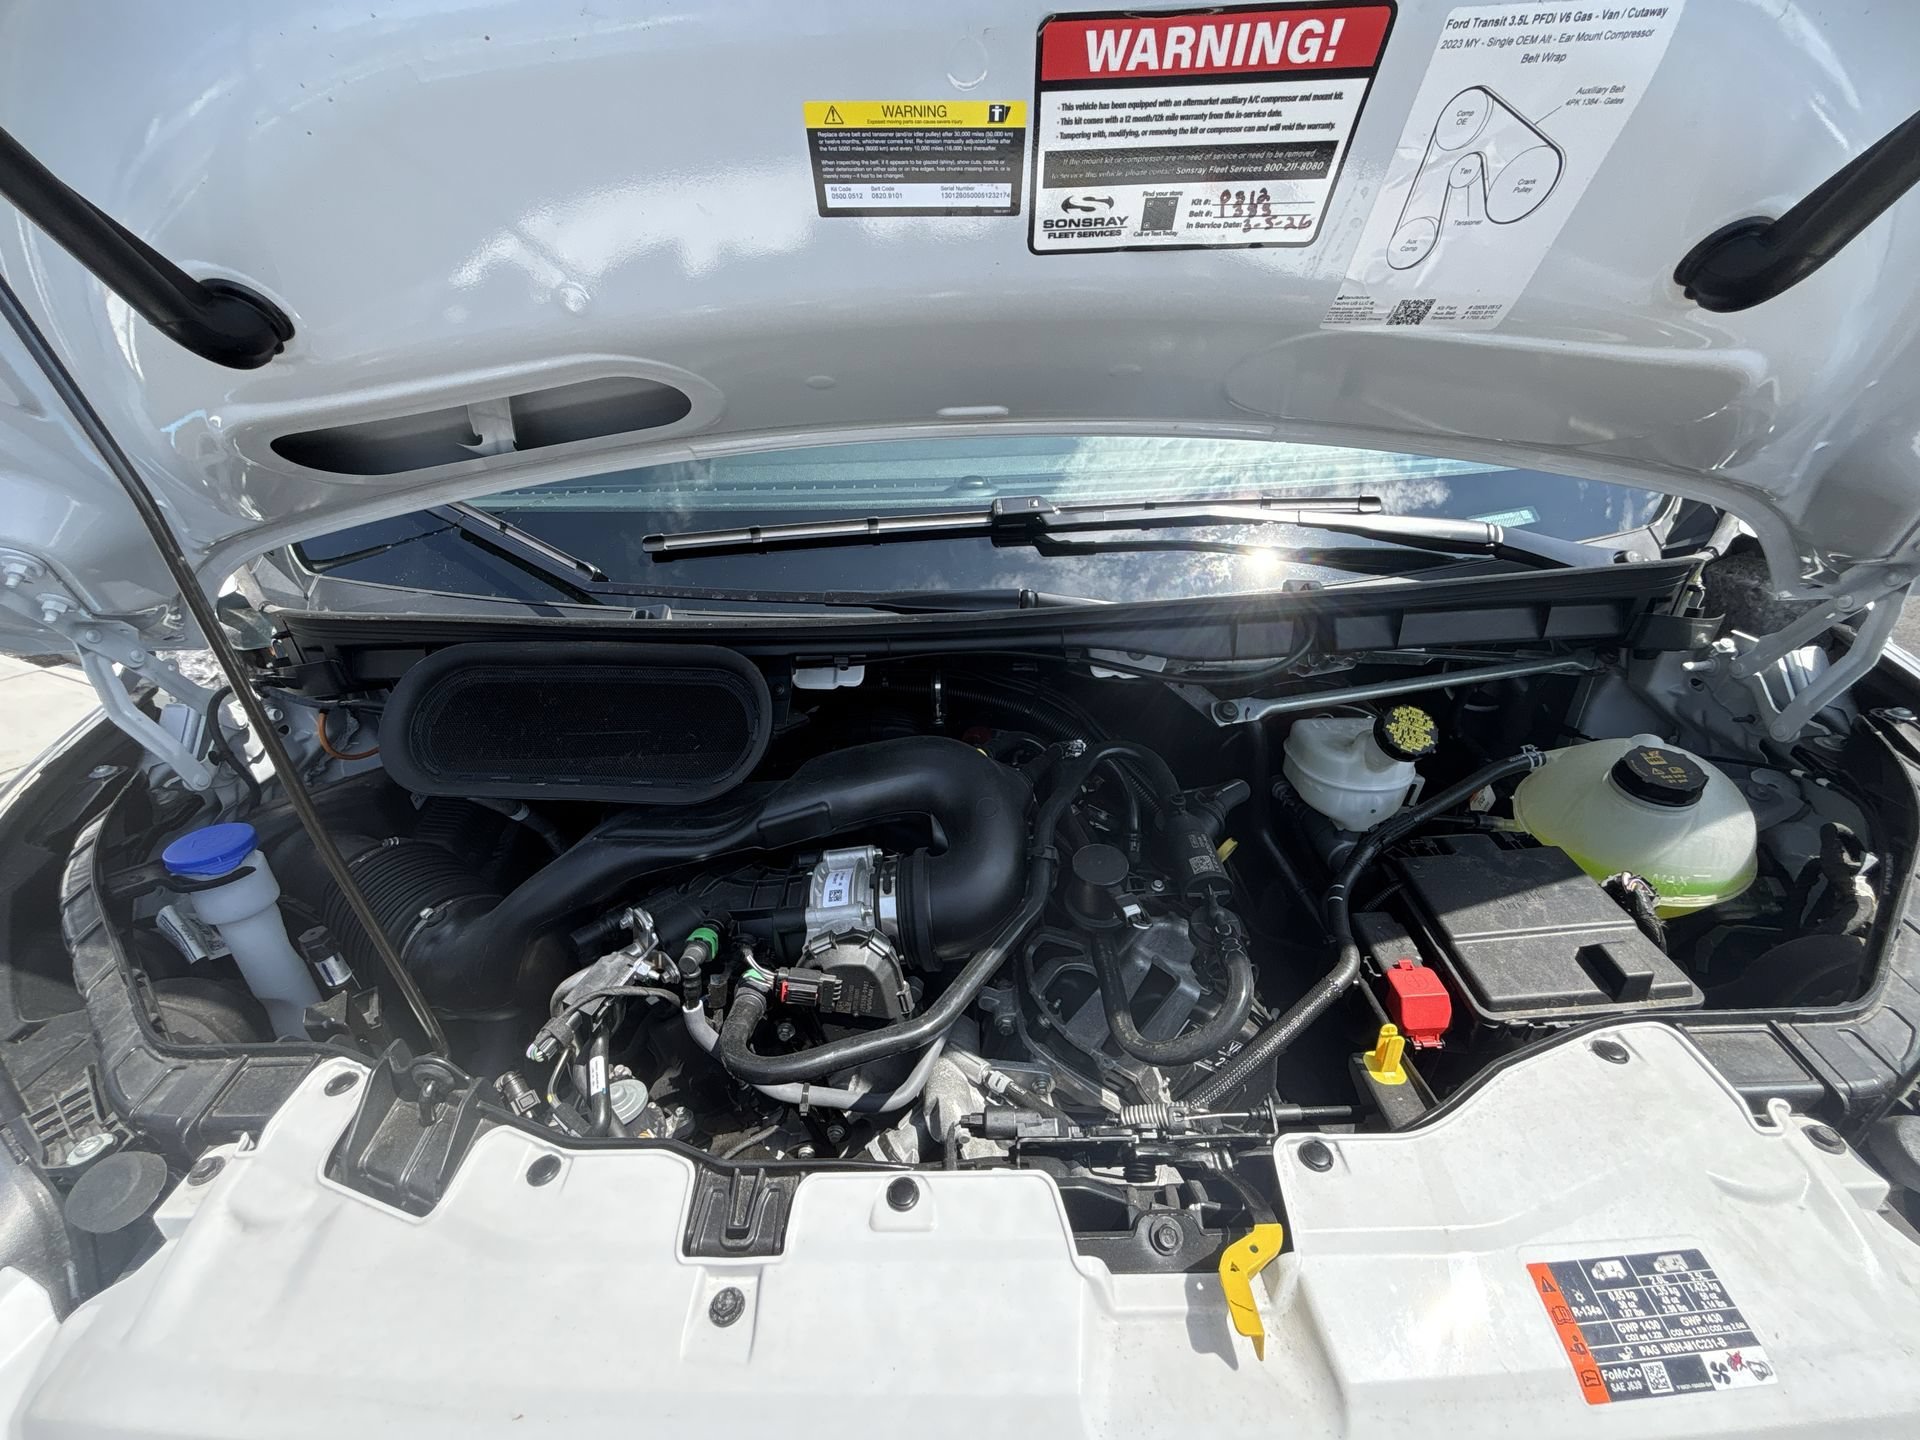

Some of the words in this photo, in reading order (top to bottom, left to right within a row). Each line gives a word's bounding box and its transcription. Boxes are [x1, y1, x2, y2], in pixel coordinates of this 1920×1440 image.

[1446, 18, 1470, 30] Ford
[1473, 16, 1507, 28] Transit
[1509, 15, 1528, 26] 3.5L
[1560, 12, 1572, 23] V6
[1574, 11, 1593, 22] Gas
[1602, 9, 1620, 20] Van
[1627, 8, 1668, 19] Cutaway
[1086, 18, 1345, 72] WARNING!
[1440, 39, 1463, 49] 2023
[1464, 38, 1480, 48] MY
[1487, 37, 1514, 48] Single
[1516, 35, 1538, 45] OEM
[1539, 34, 1552, 44] Alt
[1559, 33, 1575, 43] Ear
[1576, 31, 1603, 41] Mount
[1604, 29, 1655, 40] Compressor
[1521, 53, 1540, 63] Belt
[1541, 52, 1567, 63] Wrap
[1576, 87, 1609, 95] Auxiliary
[1609, 85, 1626, 93] Belt
[1076, 102, 1097, 110] vehicle
[1128, 100, 1157, 110] equipped
[1158, 99, 1172, 107] with
[1183, 97, 1219, 106] aftermarket
[1220, 96, 1248, 106] auxiliary
[1261, 95, 1298, 104] compressor
[1299, 93, 1312, 102] and
[1334, 92, 1343, 100] kit.
[882, 105, 947, 117] WARNING
[1105, 115, 1118, 124] with
[1166, 113, 1178, 121] mile
[1180, 112, 1208, 122] warranty
[1209, 112, 1223, 120] from
[1235, 110, 1266, 118] in-service
[1267, 109, 1282, 118] date.
[1060, 131, 1091, 140] Tampering
[1093, 130, 1107, 138] with,
[1108, 129, 1140, 138] modifying,
[1149, 128, 1177, 136] removing
[1207, 126, 1243, 135] compressor
[1282, 123, 1295, 131] void
[1296, 122, 1306, 130] the
[1307, 121, 1335, 131] warranty.
[1176, 167, 1208, 176] Sonsray
[1208, 165, 1229, 173] Fleet
[1229, 164, 1263, 173] Services
[1264, 161, 1324, 172] 800-211-8080
[1043, 216, 1129, 228] SONSRAY
[1077, 230, 1122, 238] SERVICES
[1653, 873, 1690, 886] MAX
[1570, 1304, 1603, 1317] R-134a
[1680, 1315, 1702, 1326] GWP
[1702, 1313, 1724, 1323] 1430
[1617, 1322, 1639, 1333] GWP
[1640, 1320, 1661, 1331] 1430
[1670, 1328, 1684, 1337] CO2
[1639, 1345, 1661, 1357] PAG
[1601, 1367, 1642, 1382] FoMoCo
[1610, 1382, 1627, 1393] SAE
